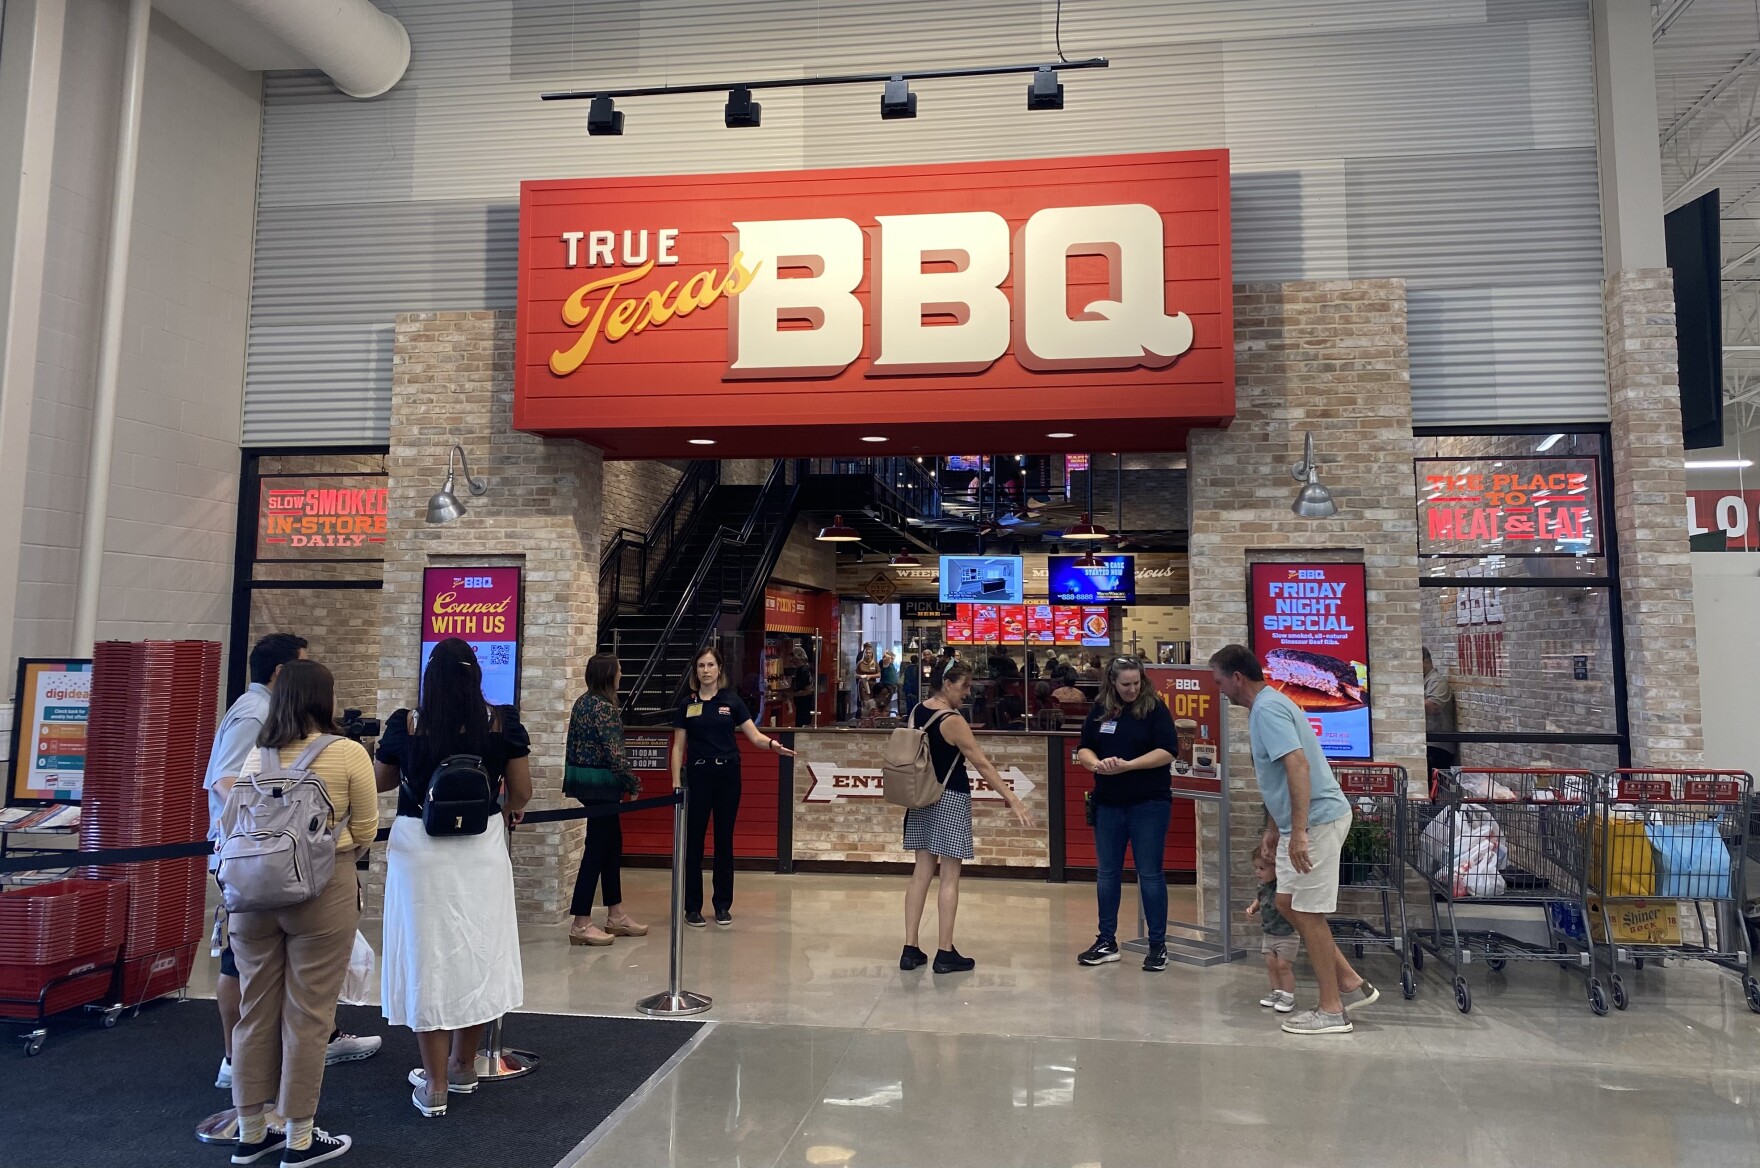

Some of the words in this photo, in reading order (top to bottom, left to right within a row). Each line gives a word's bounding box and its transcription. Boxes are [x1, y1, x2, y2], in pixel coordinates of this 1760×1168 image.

[561, 228, 679, 267] TRUE
[728, 203, 1194, 374] BBQ
[550, 250, 763, 375] Texas
[1427, 474, 1484, 491] THE
[1492, 474, 1585, 491] PLACE
[268, 496, 304, 509] SLOW
[305, 488, 388, 515] SMOKED
[1485, 492, 1526, 505] TO
[1428, 507, 1500, 540] MEAT
[1504, 515, 1535, 532] &
[1538, 507, 1587, 540] EAT
[1686, 495, 1760, 538] LO
[267, 516, 387, 534] IN-STORE
[291, 535, 366, 547] DAILY
[896, 569, 940, 578] WHER
[1298, 569, 1325, 580] BBQ
[464, 576, 493, 588] BBQ
[1269, 582, 1346, 597] FRIDAY
[433, 591, 512, 614] Connect
[906, 601, 932, 611] PICK
[1275, 599, 1341, 614] NIGHT
[431, 616, 476, 633] WITH
[482, 615, 505, 633] US
[1263, 615, 1354, 631] SPECIAL
[1175, 678, 1201, 690] BBQ
[46, 688, 90, 700] digidea
[1175, 694, 1211, 717] OFF
[832, 775, 884, 789] ENT
[1623, 908, 1661, 927] Shiner
[1630, 922, 1657, 933] BOCK
[1667, 917, 1677, 925] 18
